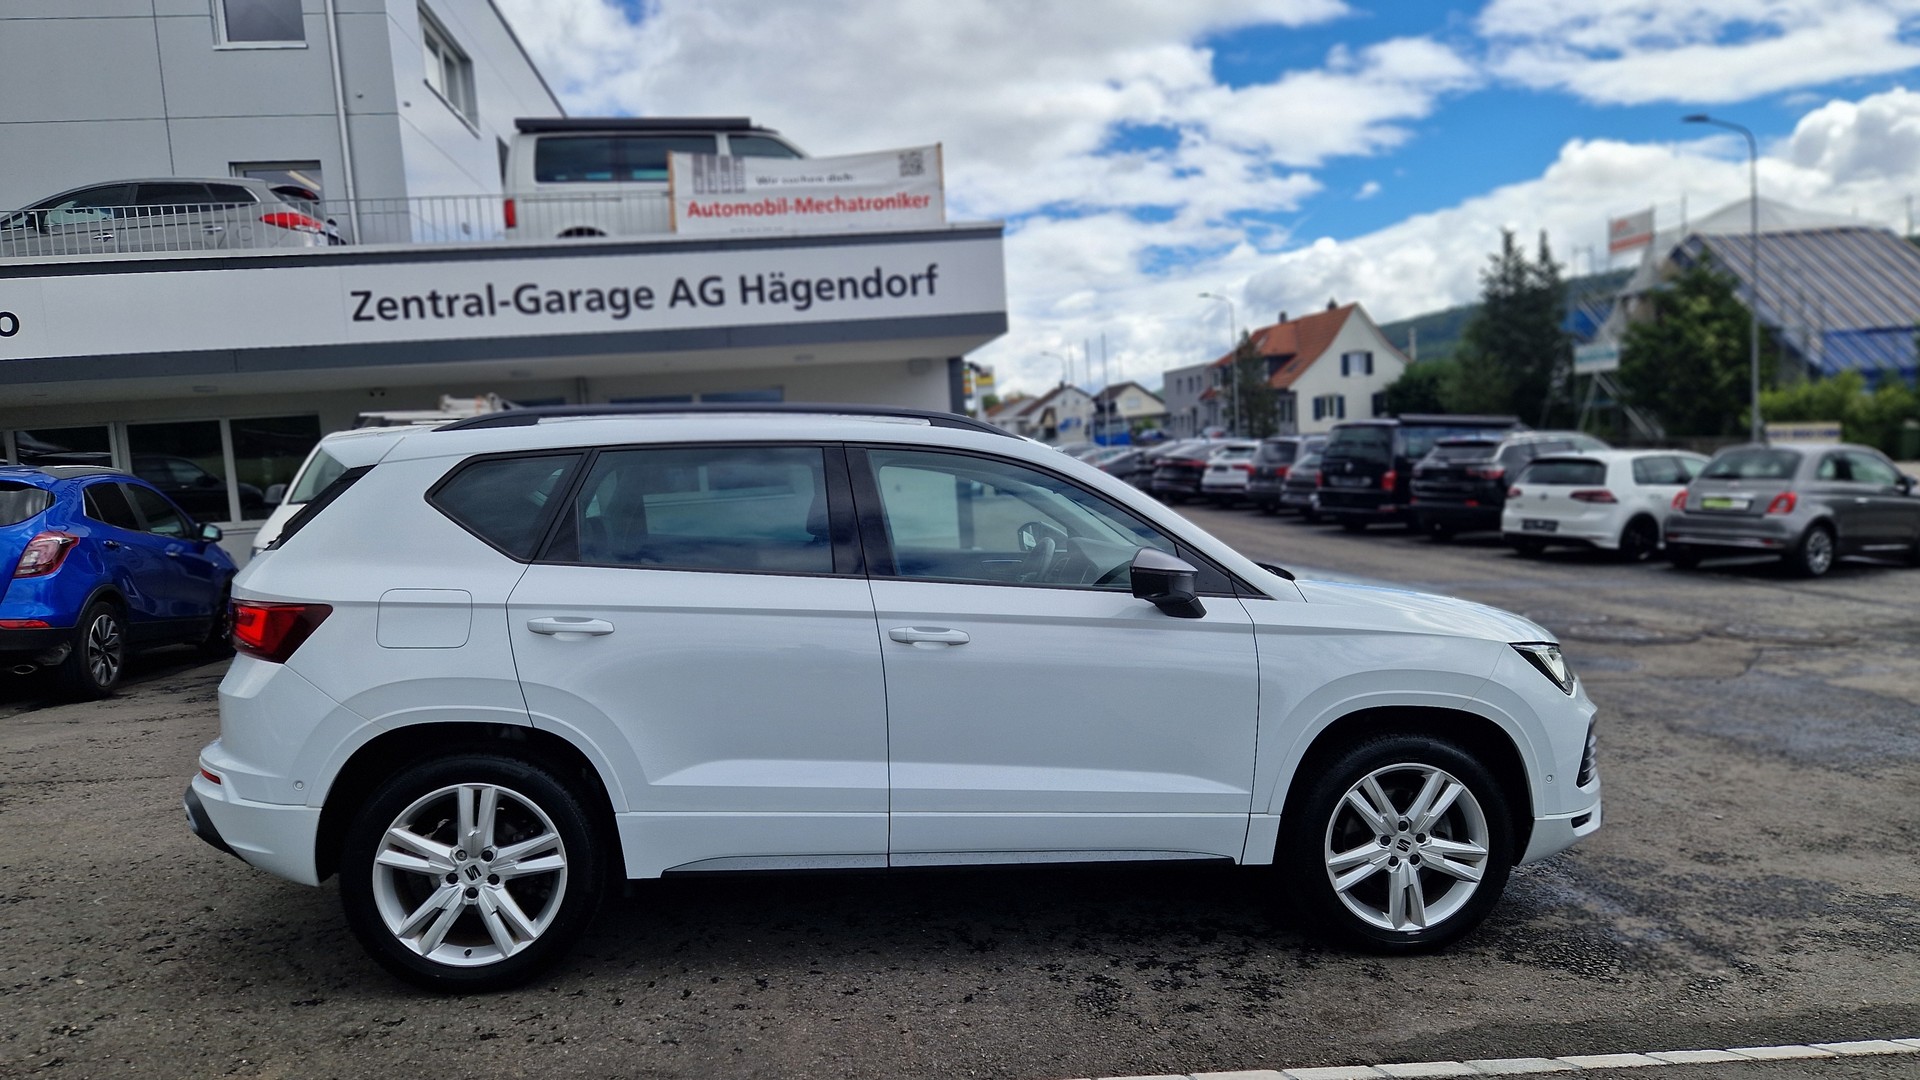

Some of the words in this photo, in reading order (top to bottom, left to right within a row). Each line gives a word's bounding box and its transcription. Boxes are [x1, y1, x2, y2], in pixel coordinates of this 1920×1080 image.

[687, 193, 931, 218] Automobil-Mechatroniker
[350, 283, 656, 322] Zentral-Garage
[669, 277, 726, 308] AG
[739, 263, 938, 312] Hägendorf
